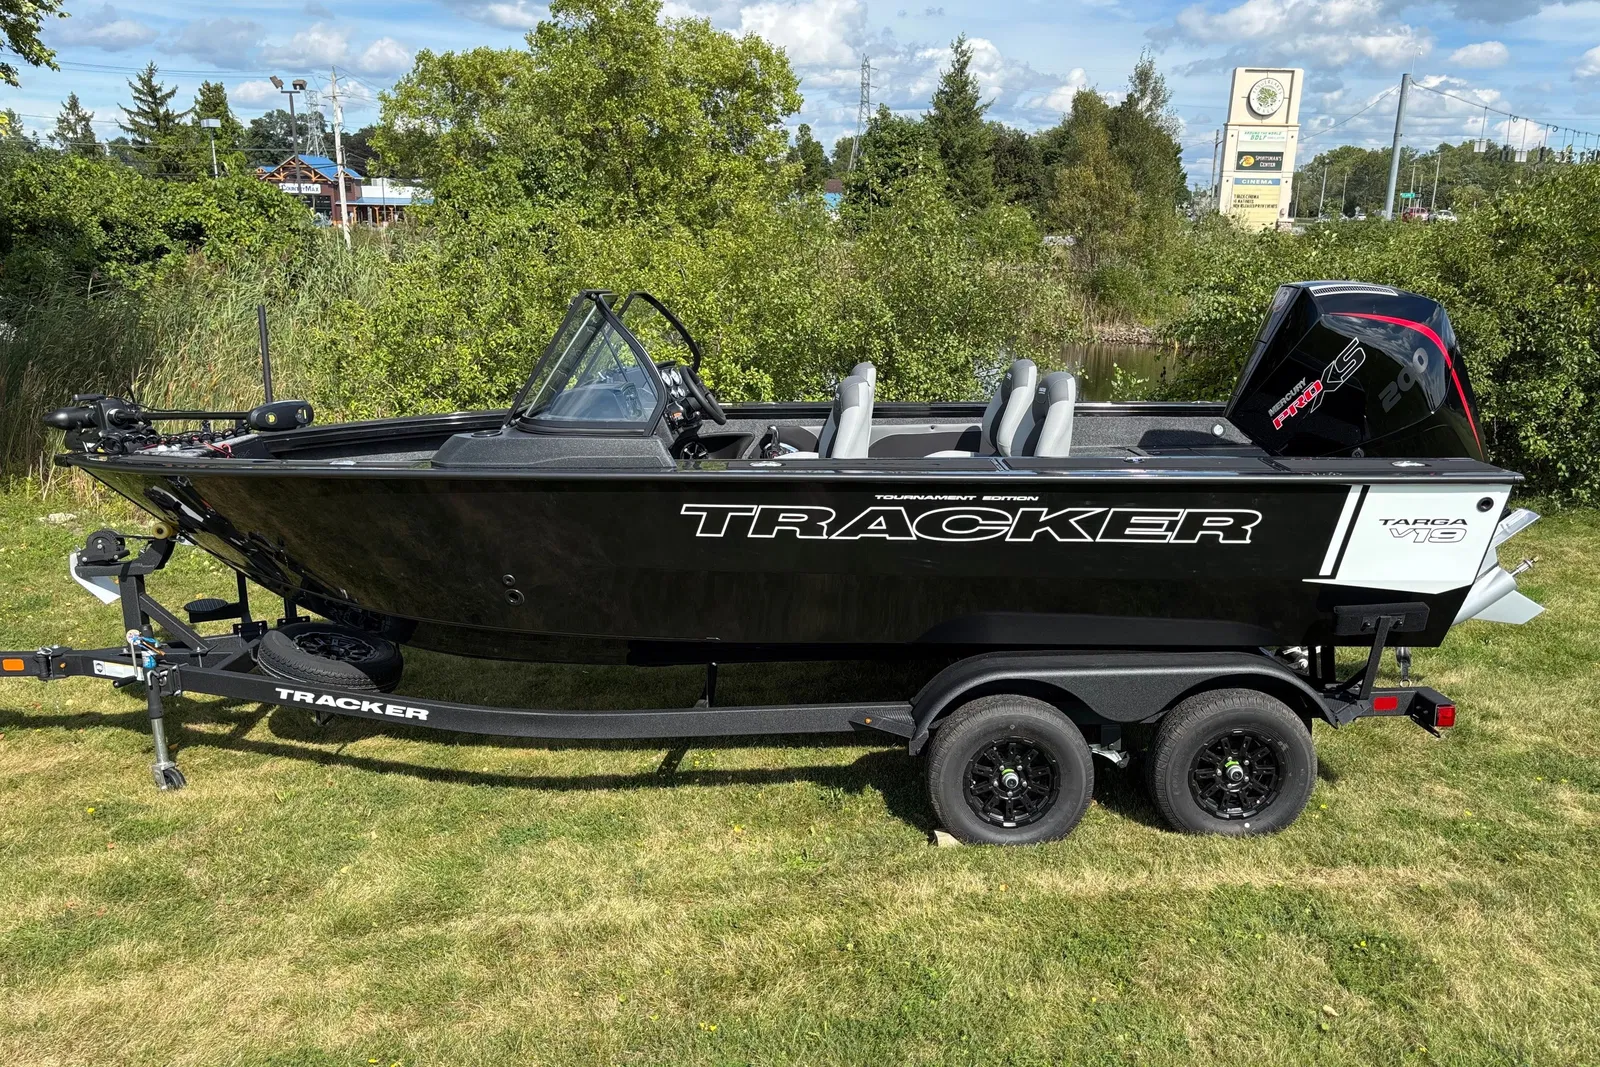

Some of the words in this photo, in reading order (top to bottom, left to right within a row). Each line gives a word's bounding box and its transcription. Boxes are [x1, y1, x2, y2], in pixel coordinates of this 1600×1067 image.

[1267, 377, 1307, 418] MERCURY
[1378, 347, 1429, 413] 200
[1272, 379, 1324, 431] PRO
[680, 504, 1264, 545] TRACKER
[1378, 518, 1468, 526] TARGA
[1389, 527, 1468, 544] V19
[274, 687, 430, 721] TRACKER
